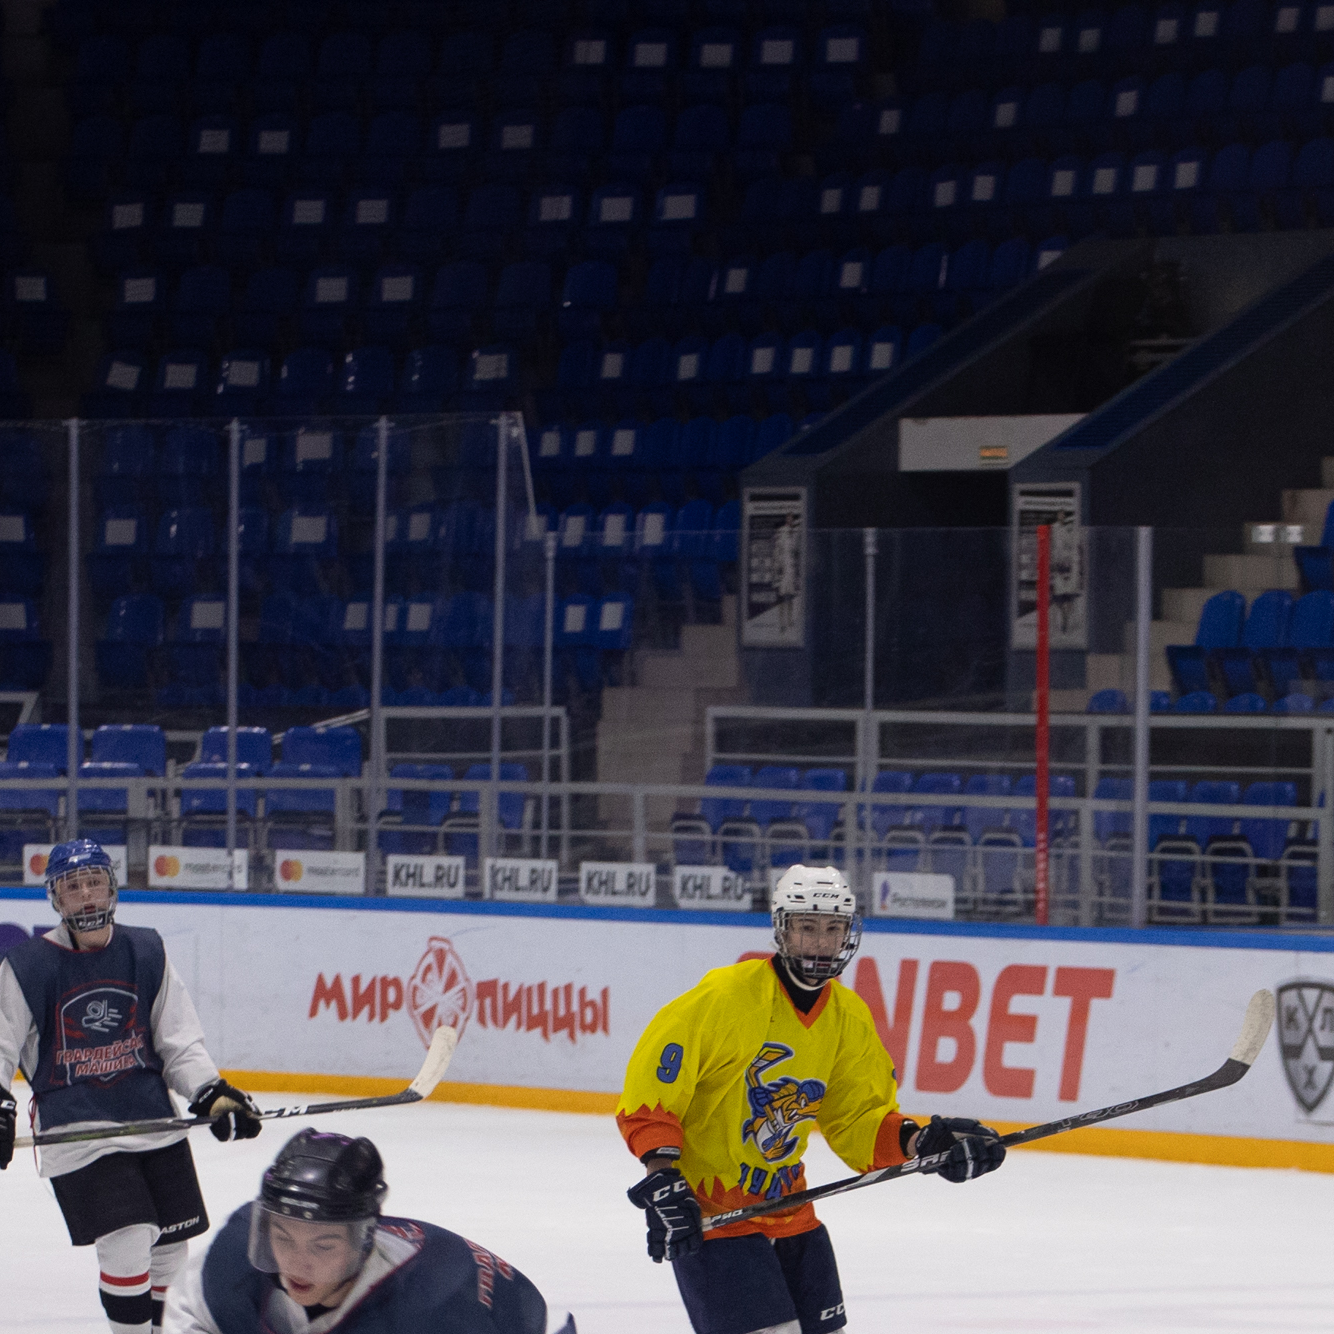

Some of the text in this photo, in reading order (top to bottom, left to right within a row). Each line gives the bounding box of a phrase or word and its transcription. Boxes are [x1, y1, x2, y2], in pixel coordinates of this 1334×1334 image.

[392, 862, 460, 890] KHL.RU
[492, 863, 553, 892] KHL.RU
[585, 869, 651, 897] KHL.RU
[812, 891, 840, 900] CCM
[308, 972, 611, 1044] МИР ПИЦЦЫ
[656, 1043, 684, 1085] 9
